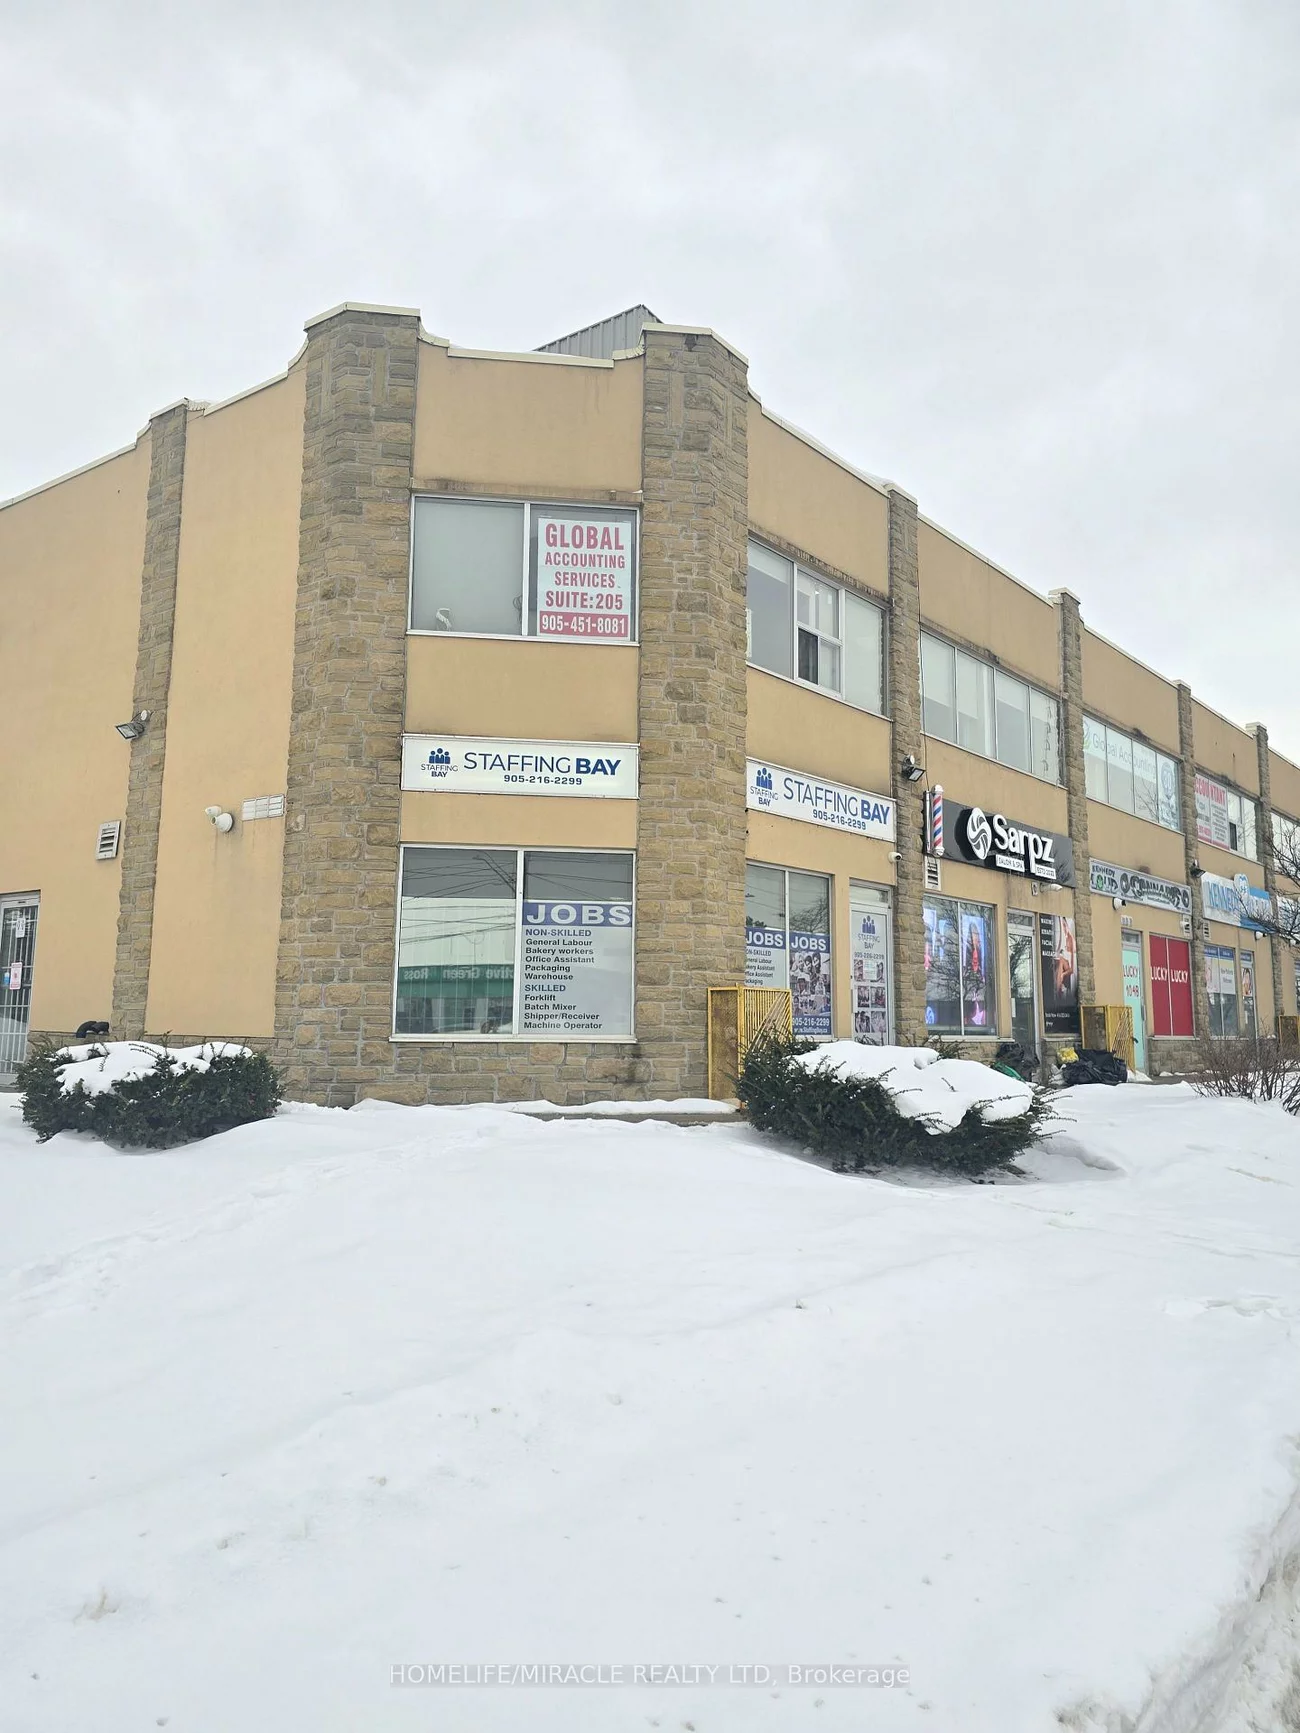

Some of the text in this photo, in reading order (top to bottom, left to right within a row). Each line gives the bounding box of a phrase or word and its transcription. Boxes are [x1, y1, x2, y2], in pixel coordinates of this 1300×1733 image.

[545, 523, 624, 550] GLOBAL
[544, 552, 625, 568] ACCOUNTING
[554, 572, 615, 588] SERVICES
[542, 614, 625, 634] 905-451-8081
[420, 763, 458, 772] STAFFING
[464, 752, 622, 776] STAFFING BAY
[504, 774, 582, 785] 905-216-2299
[750, 786, 778, 800] STAFFING
[758, 798, 771, 807] BAY
[784, 778, 890, 825] STAFFING BAY
[813, 809, 866, 830] 905-216-2299
[992, 814, 1055, 874] Sarpz
[526, 904, 631, 925] JOBS
[526, 929, 591, 937] NON-SKILLED
[746, 931, 784, 947] JOBS
[791, 936, 826, 950] JOBS
[1150, 966, 1168, 981] LUCKY
[1171, 969, 1188, 984] LUCKY
[524, 1013, 600, 1021] Shipper/Receiver
[563, 1022, 602, 1030] Operator
